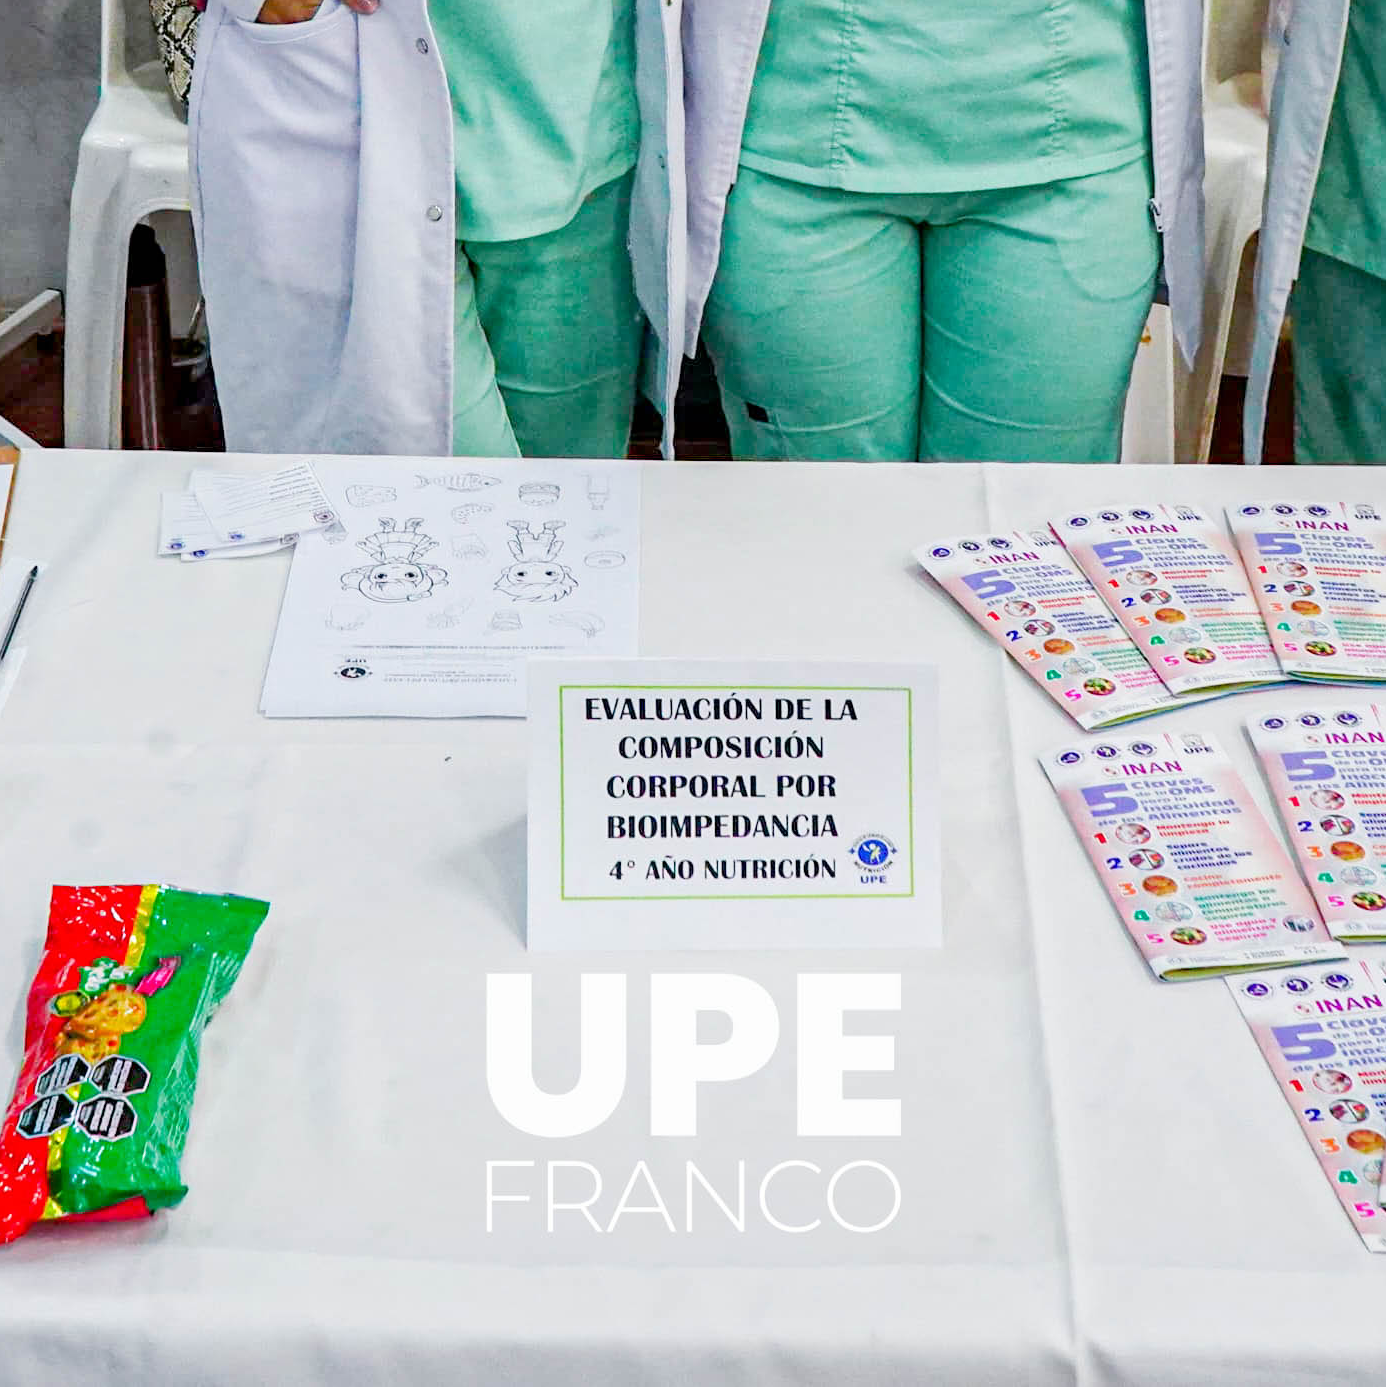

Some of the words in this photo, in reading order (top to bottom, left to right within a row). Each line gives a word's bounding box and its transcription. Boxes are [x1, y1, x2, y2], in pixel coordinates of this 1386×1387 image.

[1125, 523, 1179, 536] INAN
[1295, 519, 1350, 532] INAN
[989, 550, 1041, 566] INAN
[585, 692, 763, 721] EVALUACIÓN
[775, 698, 813, 721] DE
[824, 698, 858, 721] LA
[618, 730, 825, 760] COMPOSICIÓN
[1324, 731, 1386, 744] INAN
[1183, 746, 1213, 755] UPE
[1121, 760, 1183, 776] INAN
[606, 775, 765, 799] CORPORAL
[776, 775, 837, 798] POR
[606, 813, 839, 840] BIOIMPEDANCIA
[609, 859, 636, 881] 4°
[645, 857, 695, 881] AÑO
[704, 853, 837, 881] NUTRICIÓN
[860, 875, 887, 884] UPE
[1315, 994, 1384, 1014] INAN
[1270, 1022, 1338, 1062] 5
